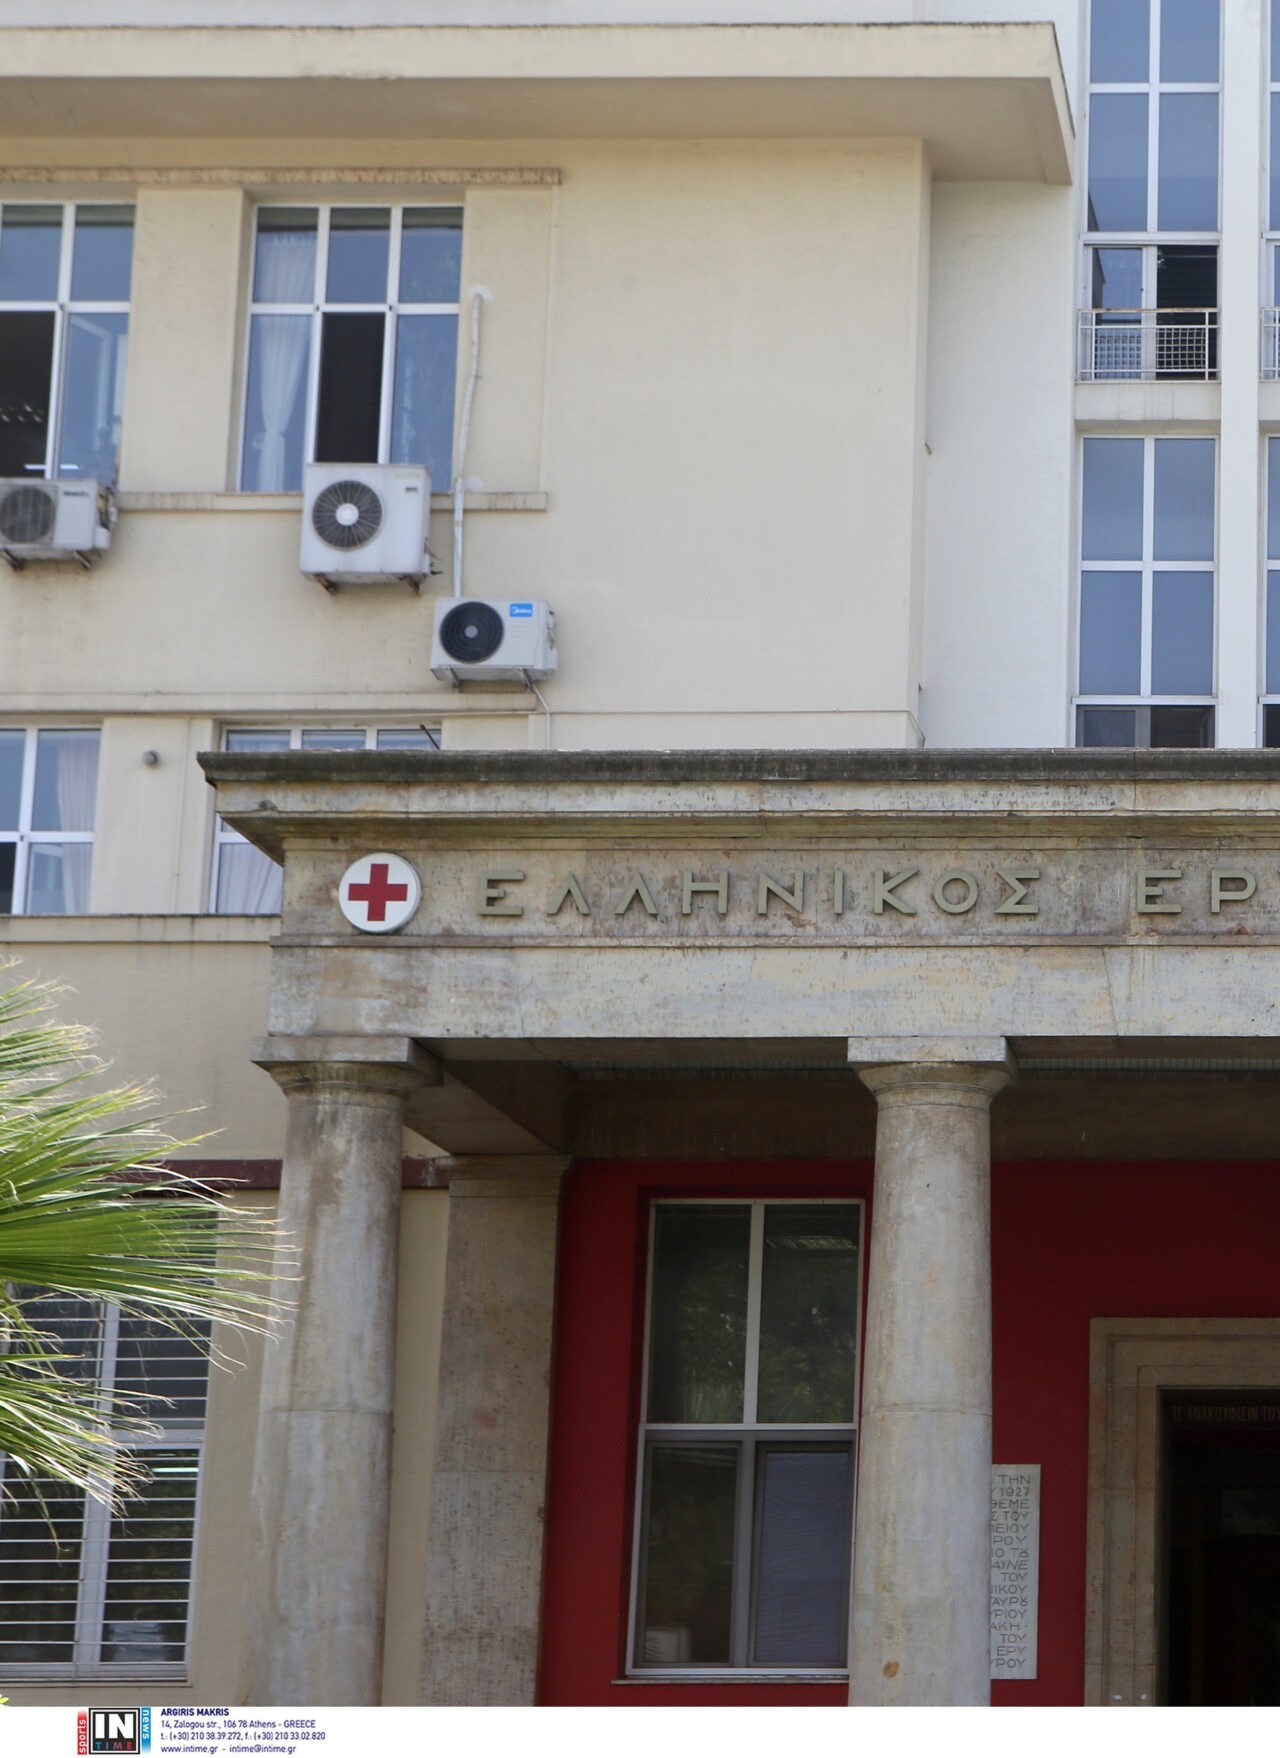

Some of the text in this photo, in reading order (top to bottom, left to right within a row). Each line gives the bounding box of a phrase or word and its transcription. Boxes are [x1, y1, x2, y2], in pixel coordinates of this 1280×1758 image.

[477, 869, 1040, 916] ΕΛΛΗΝΙΚΟΣ
[997, 1474, 1031, 1485] ΤΗΝ
[1000, 1486, 1030, 1497] 1927
[1003, 1511, 1029, 1521] ΤΟΥ
[1000, 1572, 1028, 1582] ΤΟΥ
[991, 1584, 1028, 1594] ΙΚΟΥ
[1000, 1634, 1027, 1644] ΤΟΥ
[996, 1645, 1027, 1657] ΕΡΥ
